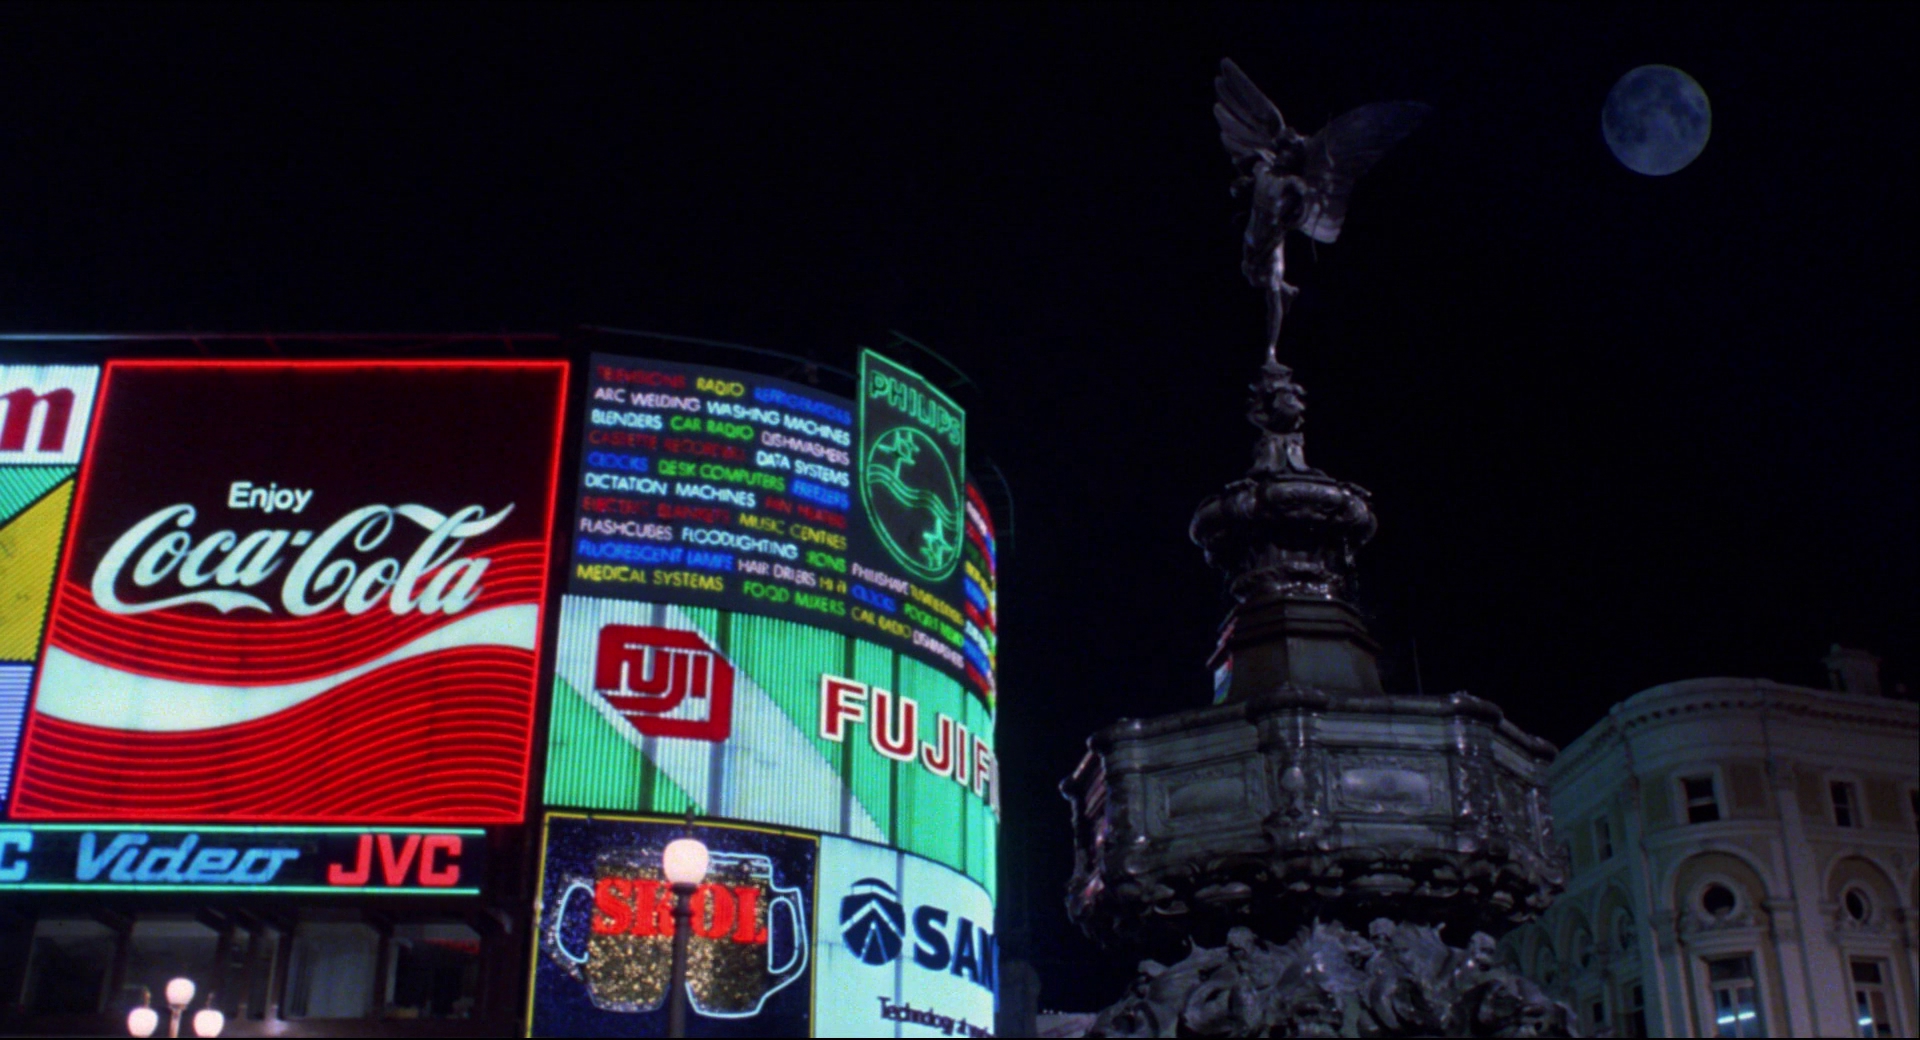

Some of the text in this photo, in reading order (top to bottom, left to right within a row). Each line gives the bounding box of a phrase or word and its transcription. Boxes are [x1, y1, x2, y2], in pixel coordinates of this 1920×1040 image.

[696, 377, 745, 397] RADIO
[869, 369, 961, 446] PHILIPS
[591, 408, 850, 467] BLENDERS CAR RADIO DISHWASHERS
[594, 387, 851, 447] ARC WELDING WASHING MACHINES
[584, 471, 757, 508] DICTATION MACHINES
[587, 451, 649, 472] CLOCKS
[658, 459, 698, 477] DESK
[700, 463, 786, 492] COMPUTERS
[756, 450, 791, 470] DATA
[794, 459, 850, 488] SYSTEMS
[228, 481, 314, 513] Enjoy
[577, 538, 684, 564] FLUORESCENT
[687, 551, 735, 572] LAMPS
[738, 559, 770, 576] HAIR
[580, 517, 673, 541] FLASHCUBES
[682, 526, 799, 560] FLOODLIGHTING
[806, 550, 846, 573] IRONS
[739, 513, 847, 550] MUSIC CENTRES
[91, 501, 516, 616] Coca-Cola
[576, 564, 647, 584] MEDICAL
[653, 569, 724, 591] SYSTEMS
[743, 580, 790, 603] FOOD
[795, 591, 847, 616] MIXERS
[75, 832, 300, 884] Video
[327, 834, 463, 886] JVC
[591, 876, 769, 945] SKOL
